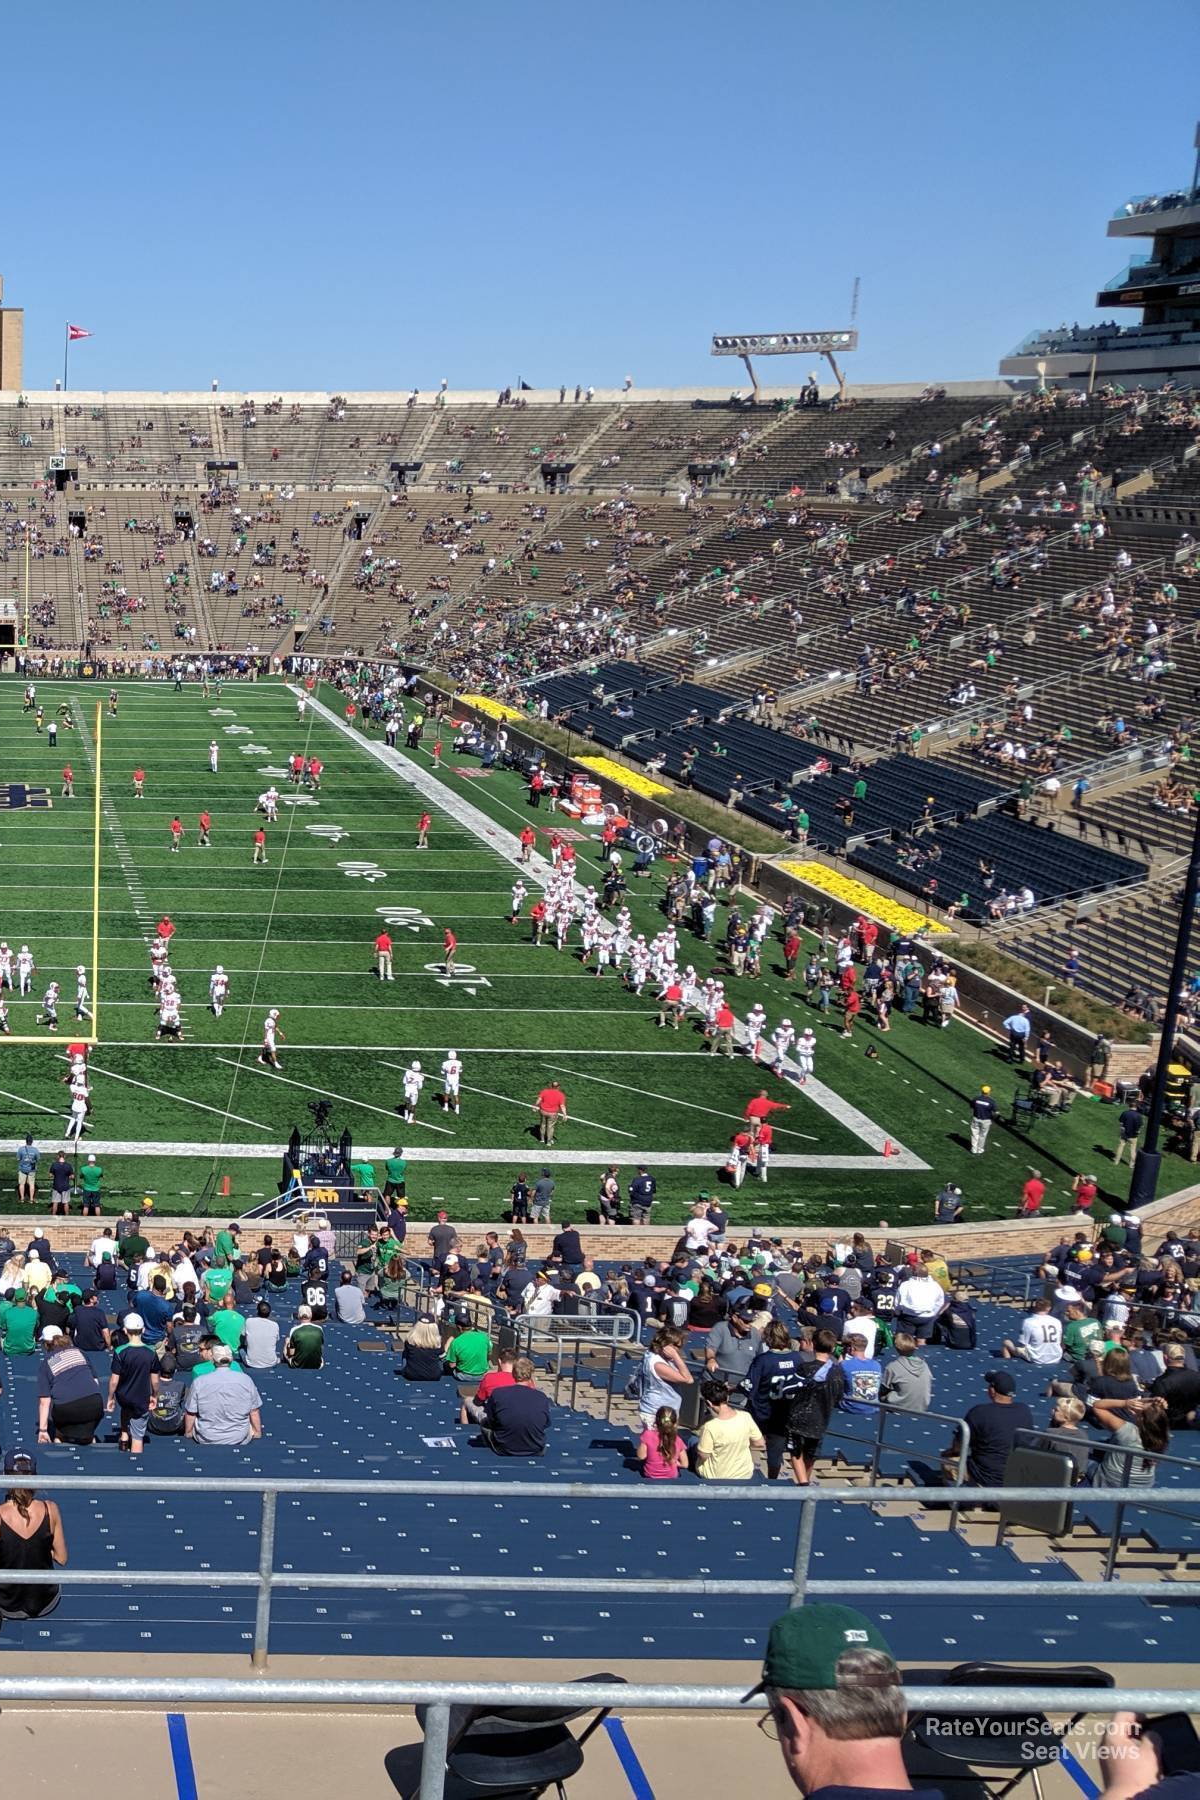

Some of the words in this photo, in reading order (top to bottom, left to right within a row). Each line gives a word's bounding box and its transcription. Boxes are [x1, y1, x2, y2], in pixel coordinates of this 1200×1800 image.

[336, 861, 387, 878] 30
[375, 907, 435, 926] 20
[423, 963, 492, 987] 10
[645, 1181, 652, 1192] 5
[318, 1259, 326, 1272] 9
[130, 1269, 137, 1282] 5
[645, 1296, 653, 1312] 1
[877, 1294, 895, 1310] 23
[1041, 1325, 1057, 1343] 12
[779, 1361, 794, 1369] IRISH
